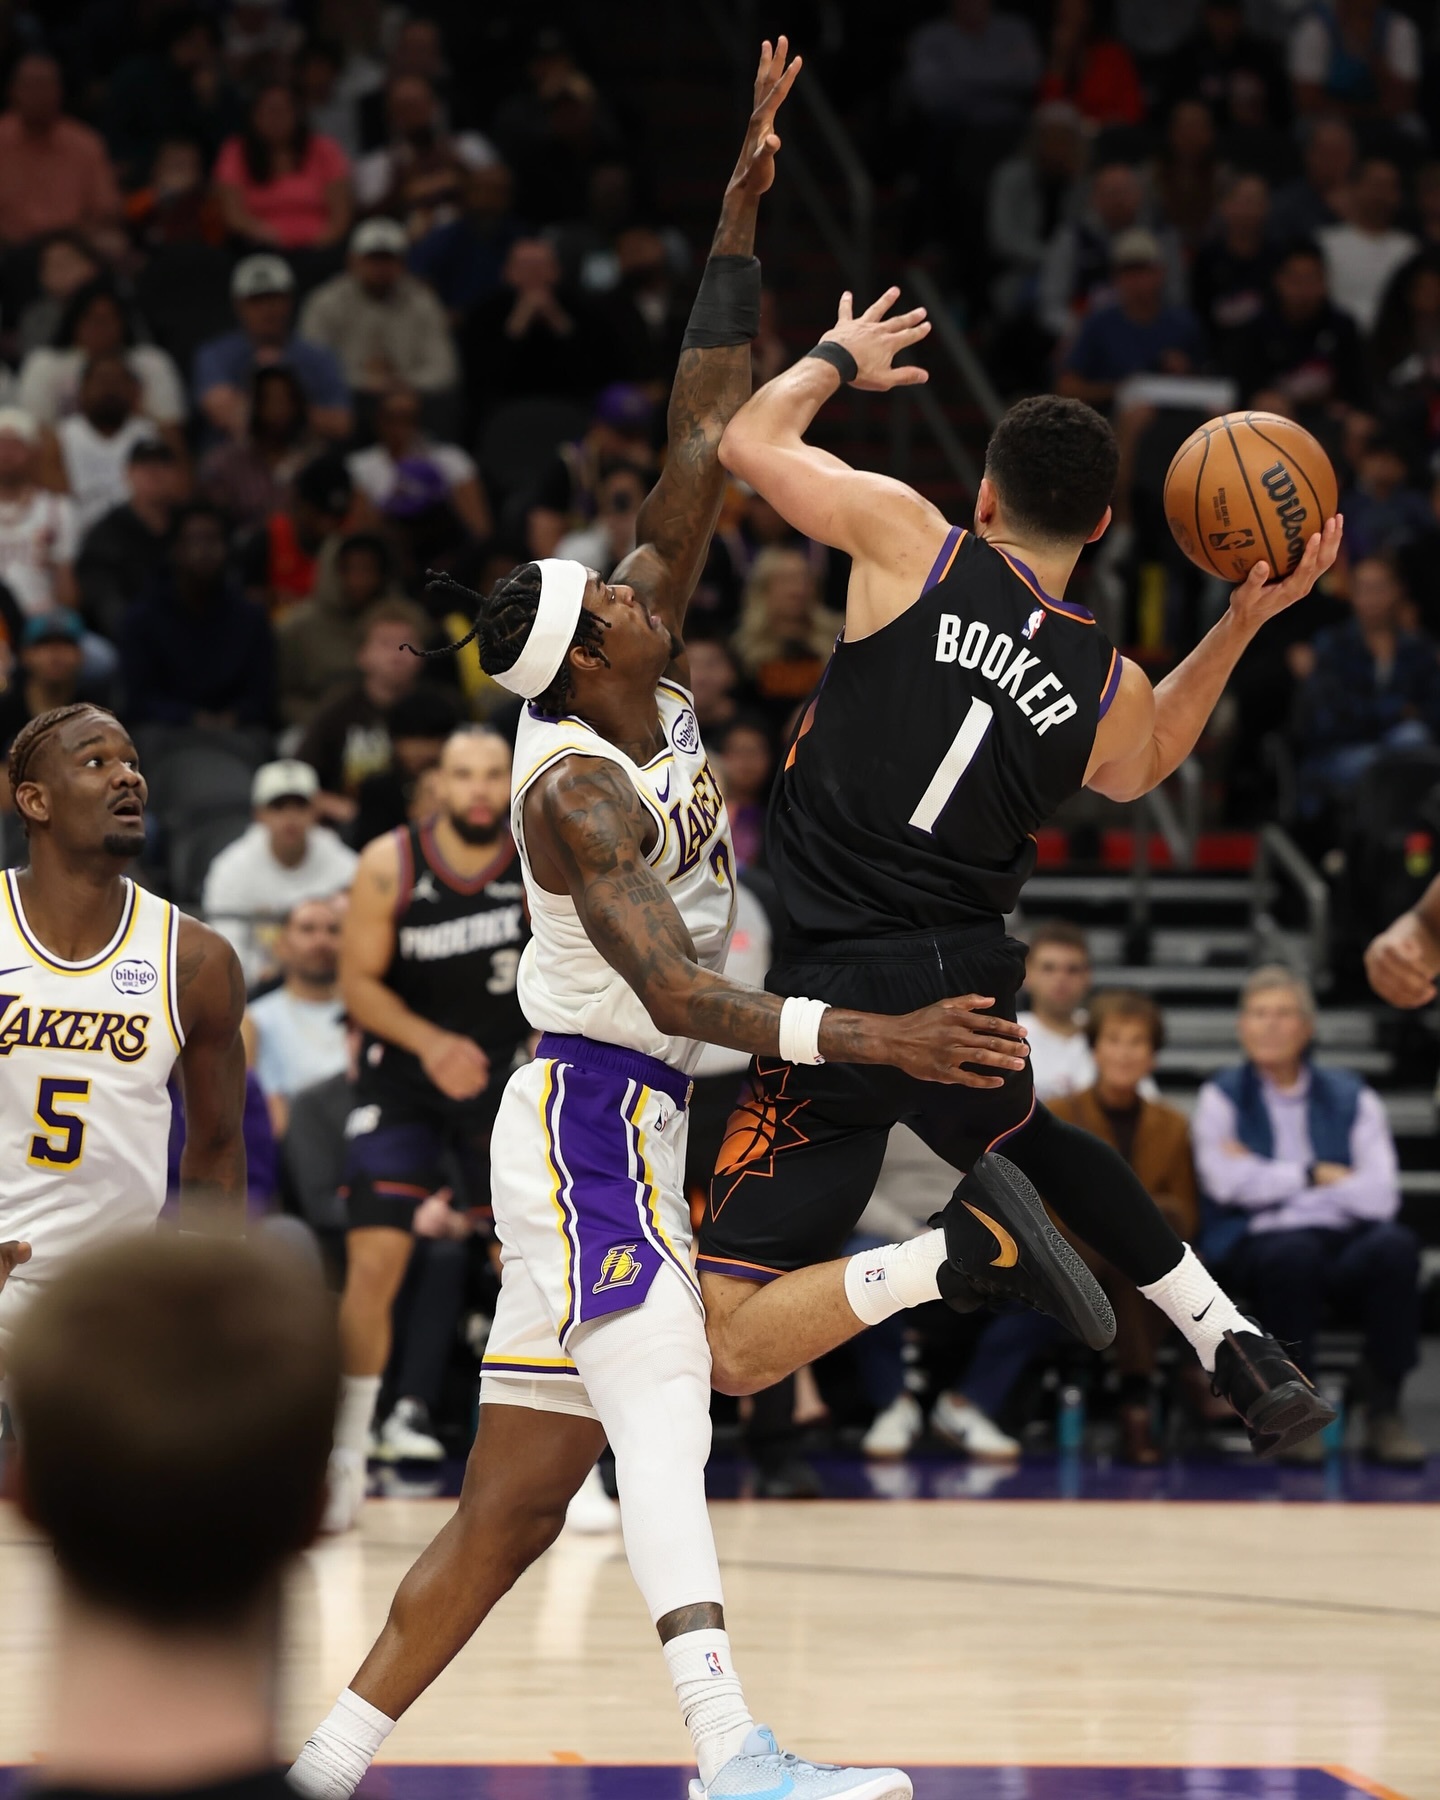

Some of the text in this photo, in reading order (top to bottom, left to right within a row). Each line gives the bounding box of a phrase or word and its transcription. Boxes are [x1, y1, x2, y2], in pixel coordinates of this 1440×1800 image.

[935, 613, 1078, 736] BOOKER
[908, 695, 995, 835] 1
[115, 968, 155, 985] bibigo
[485, 949, 520, 995] 3
[27, 1075, 92, 1172] 5
